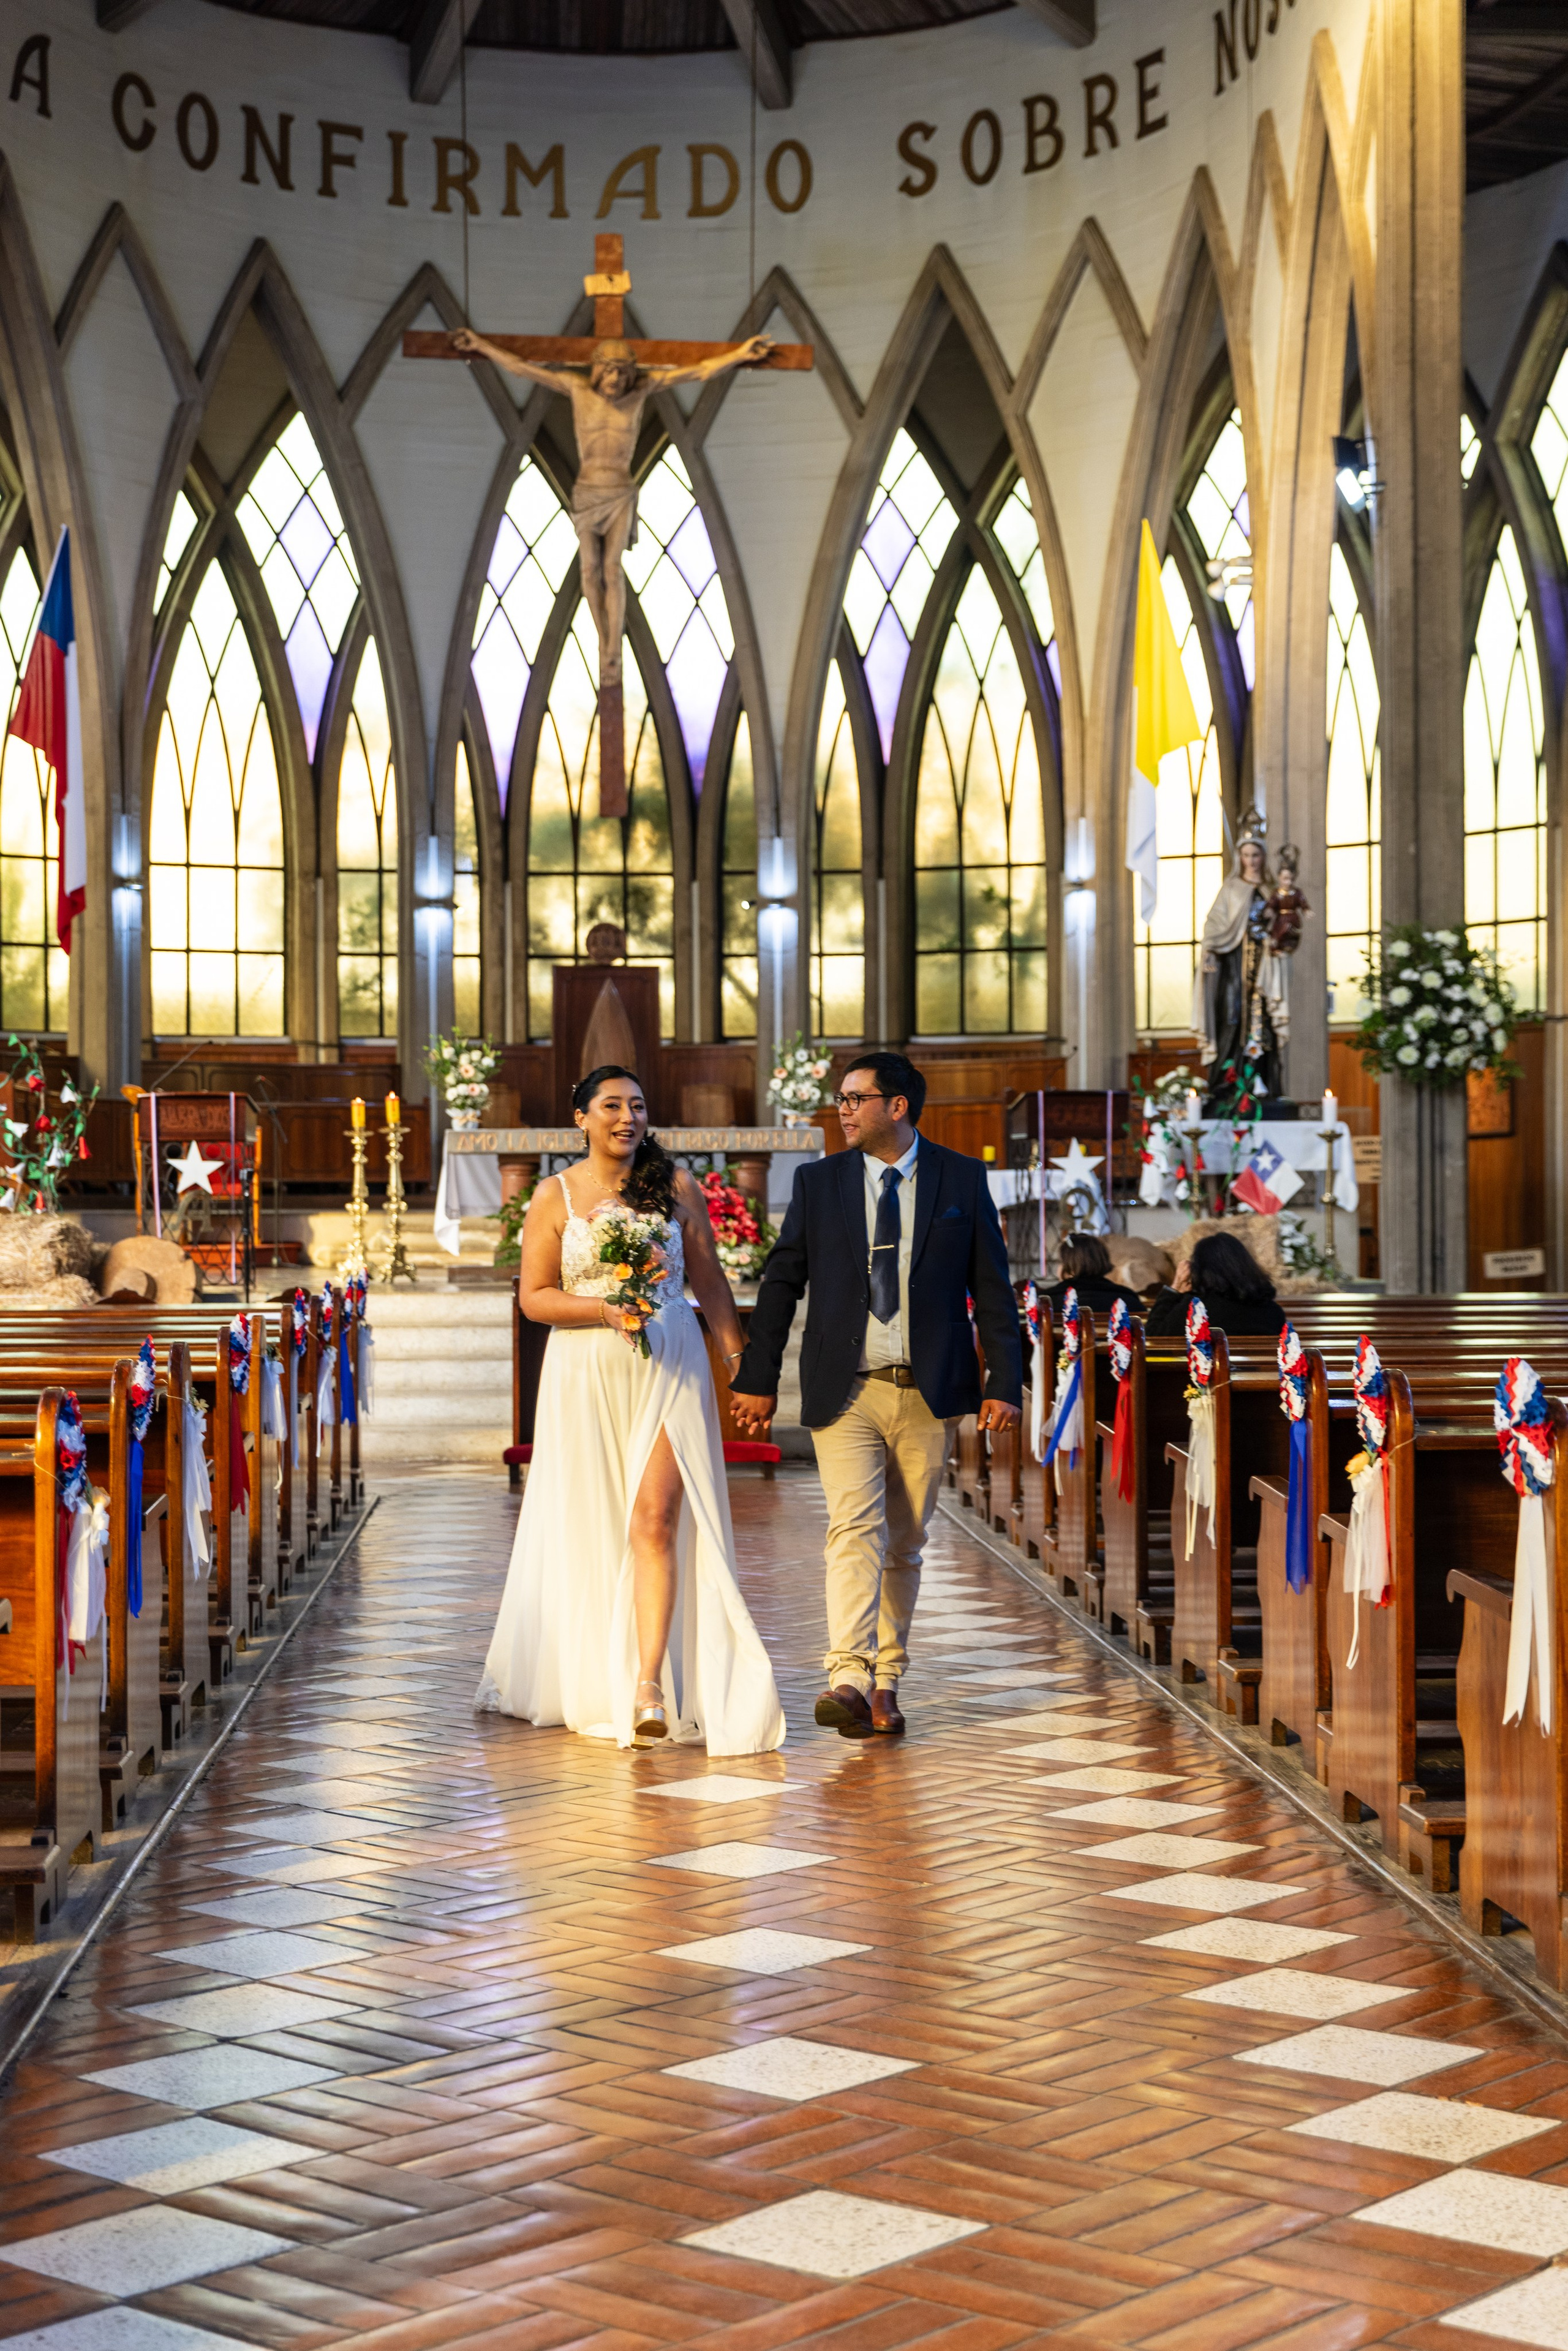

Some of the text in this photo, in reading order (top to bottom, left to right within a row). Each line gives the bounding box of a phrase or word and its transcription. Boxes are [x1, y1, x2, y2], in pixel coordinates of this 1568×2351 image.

[112, 72, 813, 221] CONFIRMADO
[897, 47, 1169, 198] SOBRE
[457, 1133, 498, 1150] AMO
[507, 1133, 531, 1150] LA
[537, 1132, 582, 1150] IGLES
[659, 1131, 729, 1150] NTREGO
[772, 1132, 816, 1149] ELLA
